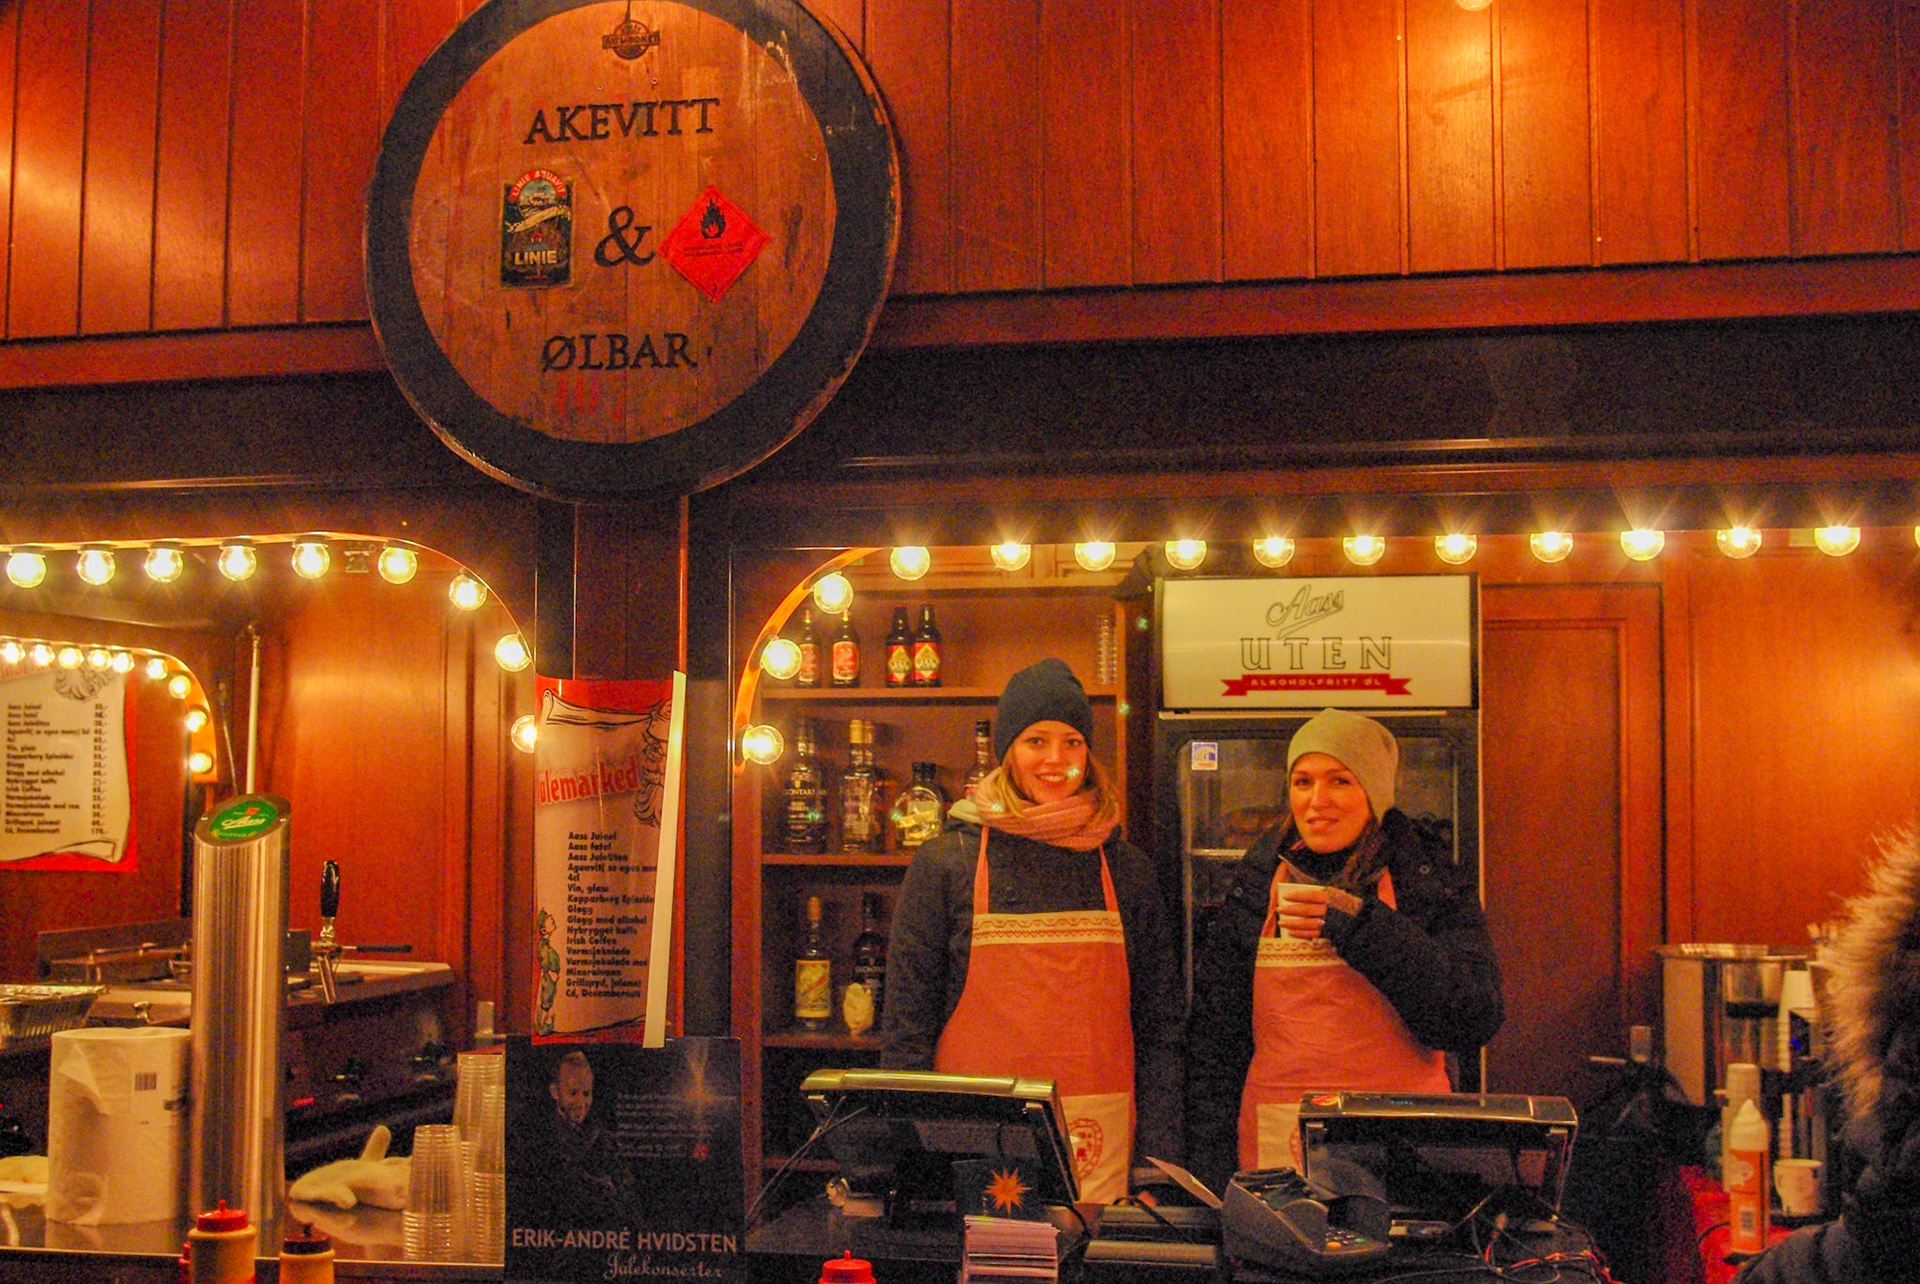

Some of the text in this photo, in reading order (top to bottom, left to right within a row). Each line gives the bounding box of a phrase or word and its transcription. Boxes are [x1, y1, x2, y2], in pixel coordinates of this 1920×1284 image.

[523, 98, 720, 144] AKEVITT
[510, 173, 532, 197] LINIE
[594, 206, 656, 267] &
[514, 250, 557, 266] LINIE
[541, 332, 699, 373] ØLBAR
[1265, 584, 1344, 640] Aass
[1240, 636, 1392, 671] UTEN
[1250, 676, 1382, 687] ALKOHOLFRITT ØL
[568, 831, 588, 840] Aass
[568, 842, 588, 850] Aass
[568, 852, 588, 861] Aass
[587, 883, 609, 894] glass
[566, 936, 617, 946] Irish Coffee
[512, 1226, 737, 1252] ERIK-ANDRÉ HVIDSTEN
[603, 1251, 723, 1280] Julekonserter
